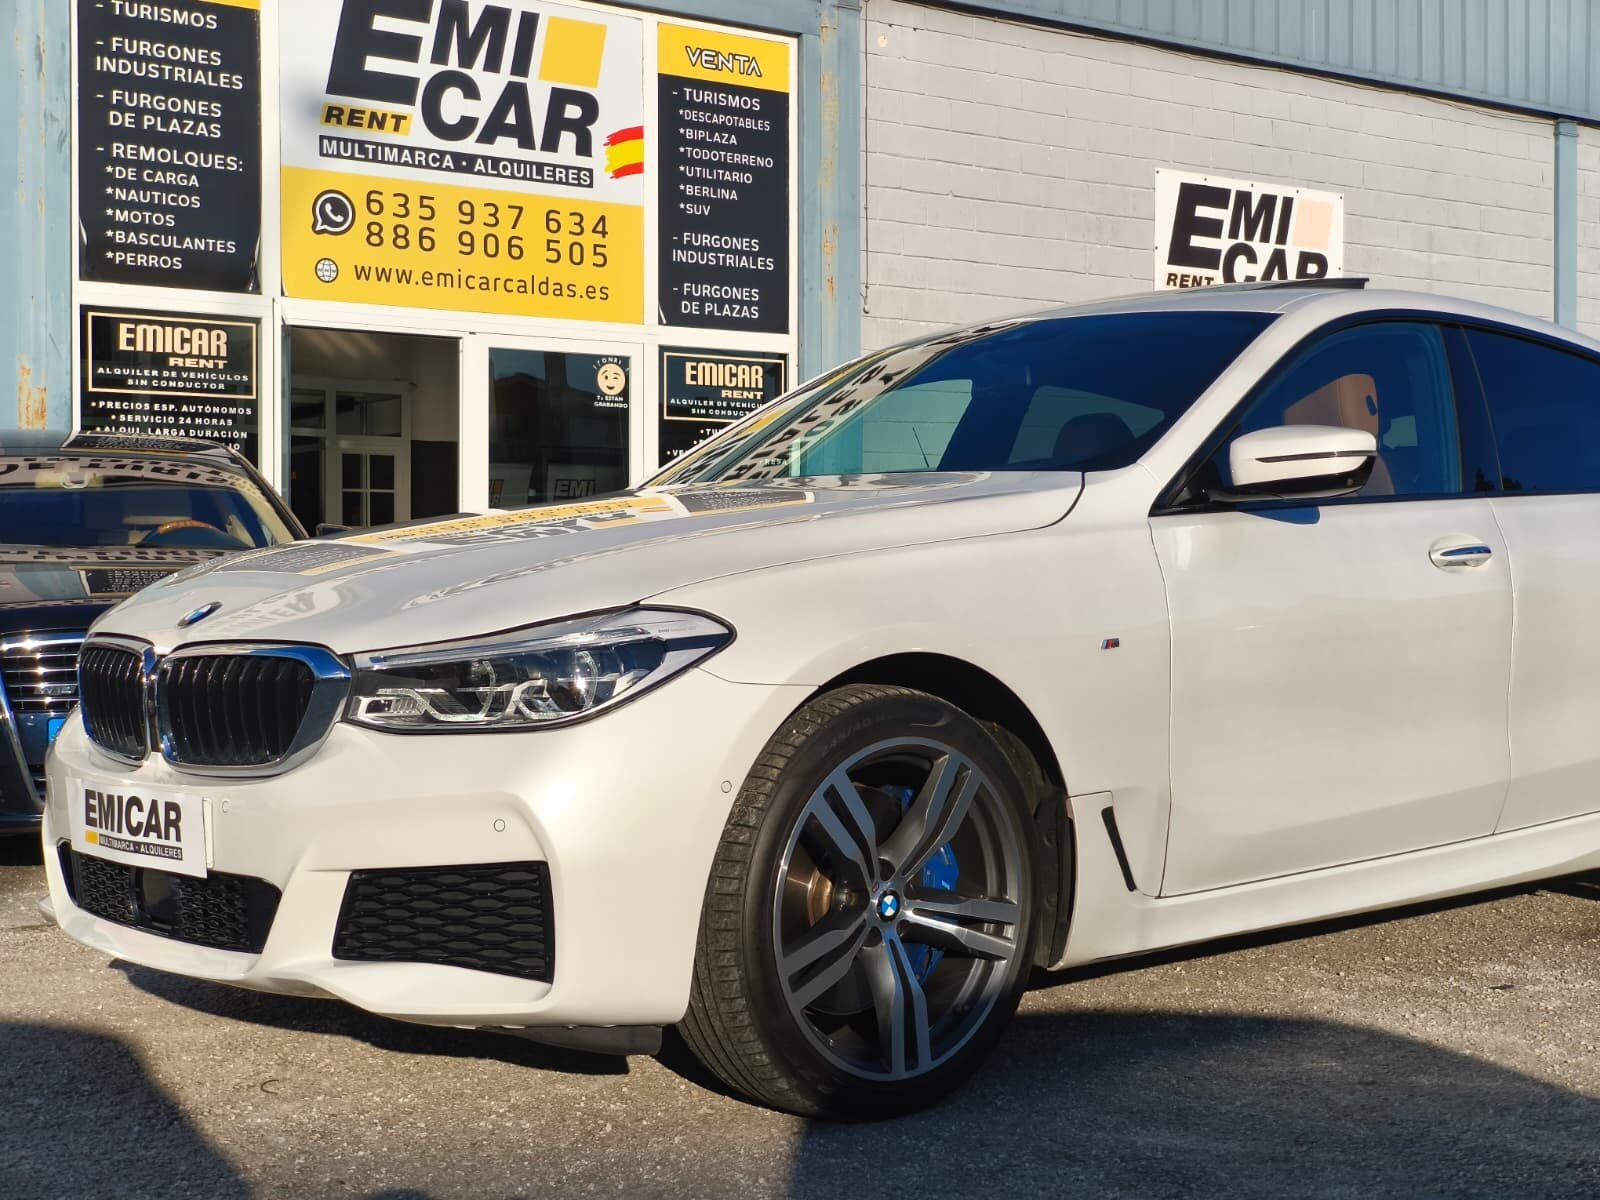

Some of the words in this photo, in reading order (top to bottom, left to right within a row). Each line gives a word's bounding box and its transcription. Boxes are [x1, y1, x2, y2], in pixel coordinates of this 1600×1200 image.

[112, 0, 218, 30] TURISMOS
[112, 37, 222, 66] FURGONES
[326, 0, 540, 107] EMI
[684, 45, 763, 78] VENTA
[96, 56, 243, 90] INDUSTRIALES
[112, 90, 222, 118] FURGONES
[683, 87, 761, 111] TURISMOS
[109, 112, 136, 128] DE
[144, 115, 222, 139] PLAZAS
[325, 105, 408, 133] RENT
[421, 70, 600, 158] CAR
[112, 143, 244, 172] REMOLQUES:
[323, 139, 454, 170] MULTIMARCA
[474, 158, 591, 186] ALQUILERES
[144, 170, 200, 188] CARGA
[366, 190, 436, 221] 635
[458, 200, 524, 230] 937
[545, 209, 609, 239] 634
[1167, 182, 1294, 270] EMI
[366, 222, 436, 252] 886
[458, 231, 524, 261] 906
[545, 239, 609, 268] 505
[683, 232, 760, 252] FURGONES
[672, 249, 774, 271] INDUSTRIALES
[354, 264, 609, 301] www.emicarcaldas.es
[683, 283, 759, 301] FURGONES
[1166, 272, 1214, 288] RENT
[681, 301, 700, 315] DE
[704, 303, 759, 319] PLAZAS
[119, 322, 228, 357] EMICAR
[97, 367, 159, 378] ALQUILER
[163, 370, 177, 378] DE
[168, 357, 228, 369] RENT
[685, 361, 764, 389] EMICAR
[127, 378, 148, 386] SIN
[152, 380, 226, 390] CONDUCTOR
[721, 389, 764, 399] RENT
[99, 401, 150, 411] PRECIOS
[153, 404, 179, 412] ESP.
[182, 404, 252, 415] AUTÓNOMOS
[670, 398, 714, 407] ALQUILER
[119, 414, 175, 424] SERVICIO
[178, 416, 192, 425] 24
[195, 418, 233, 426] HORAS
[148, 428, 186, 437] LARGA
[189, 428, 247, 439] DURACIÓN
[85, 789, 182, 842] EMICAR
[100, 836, 134, 851] MULTIMARCA
[140, 844, 182, 859] ALQUILERES
